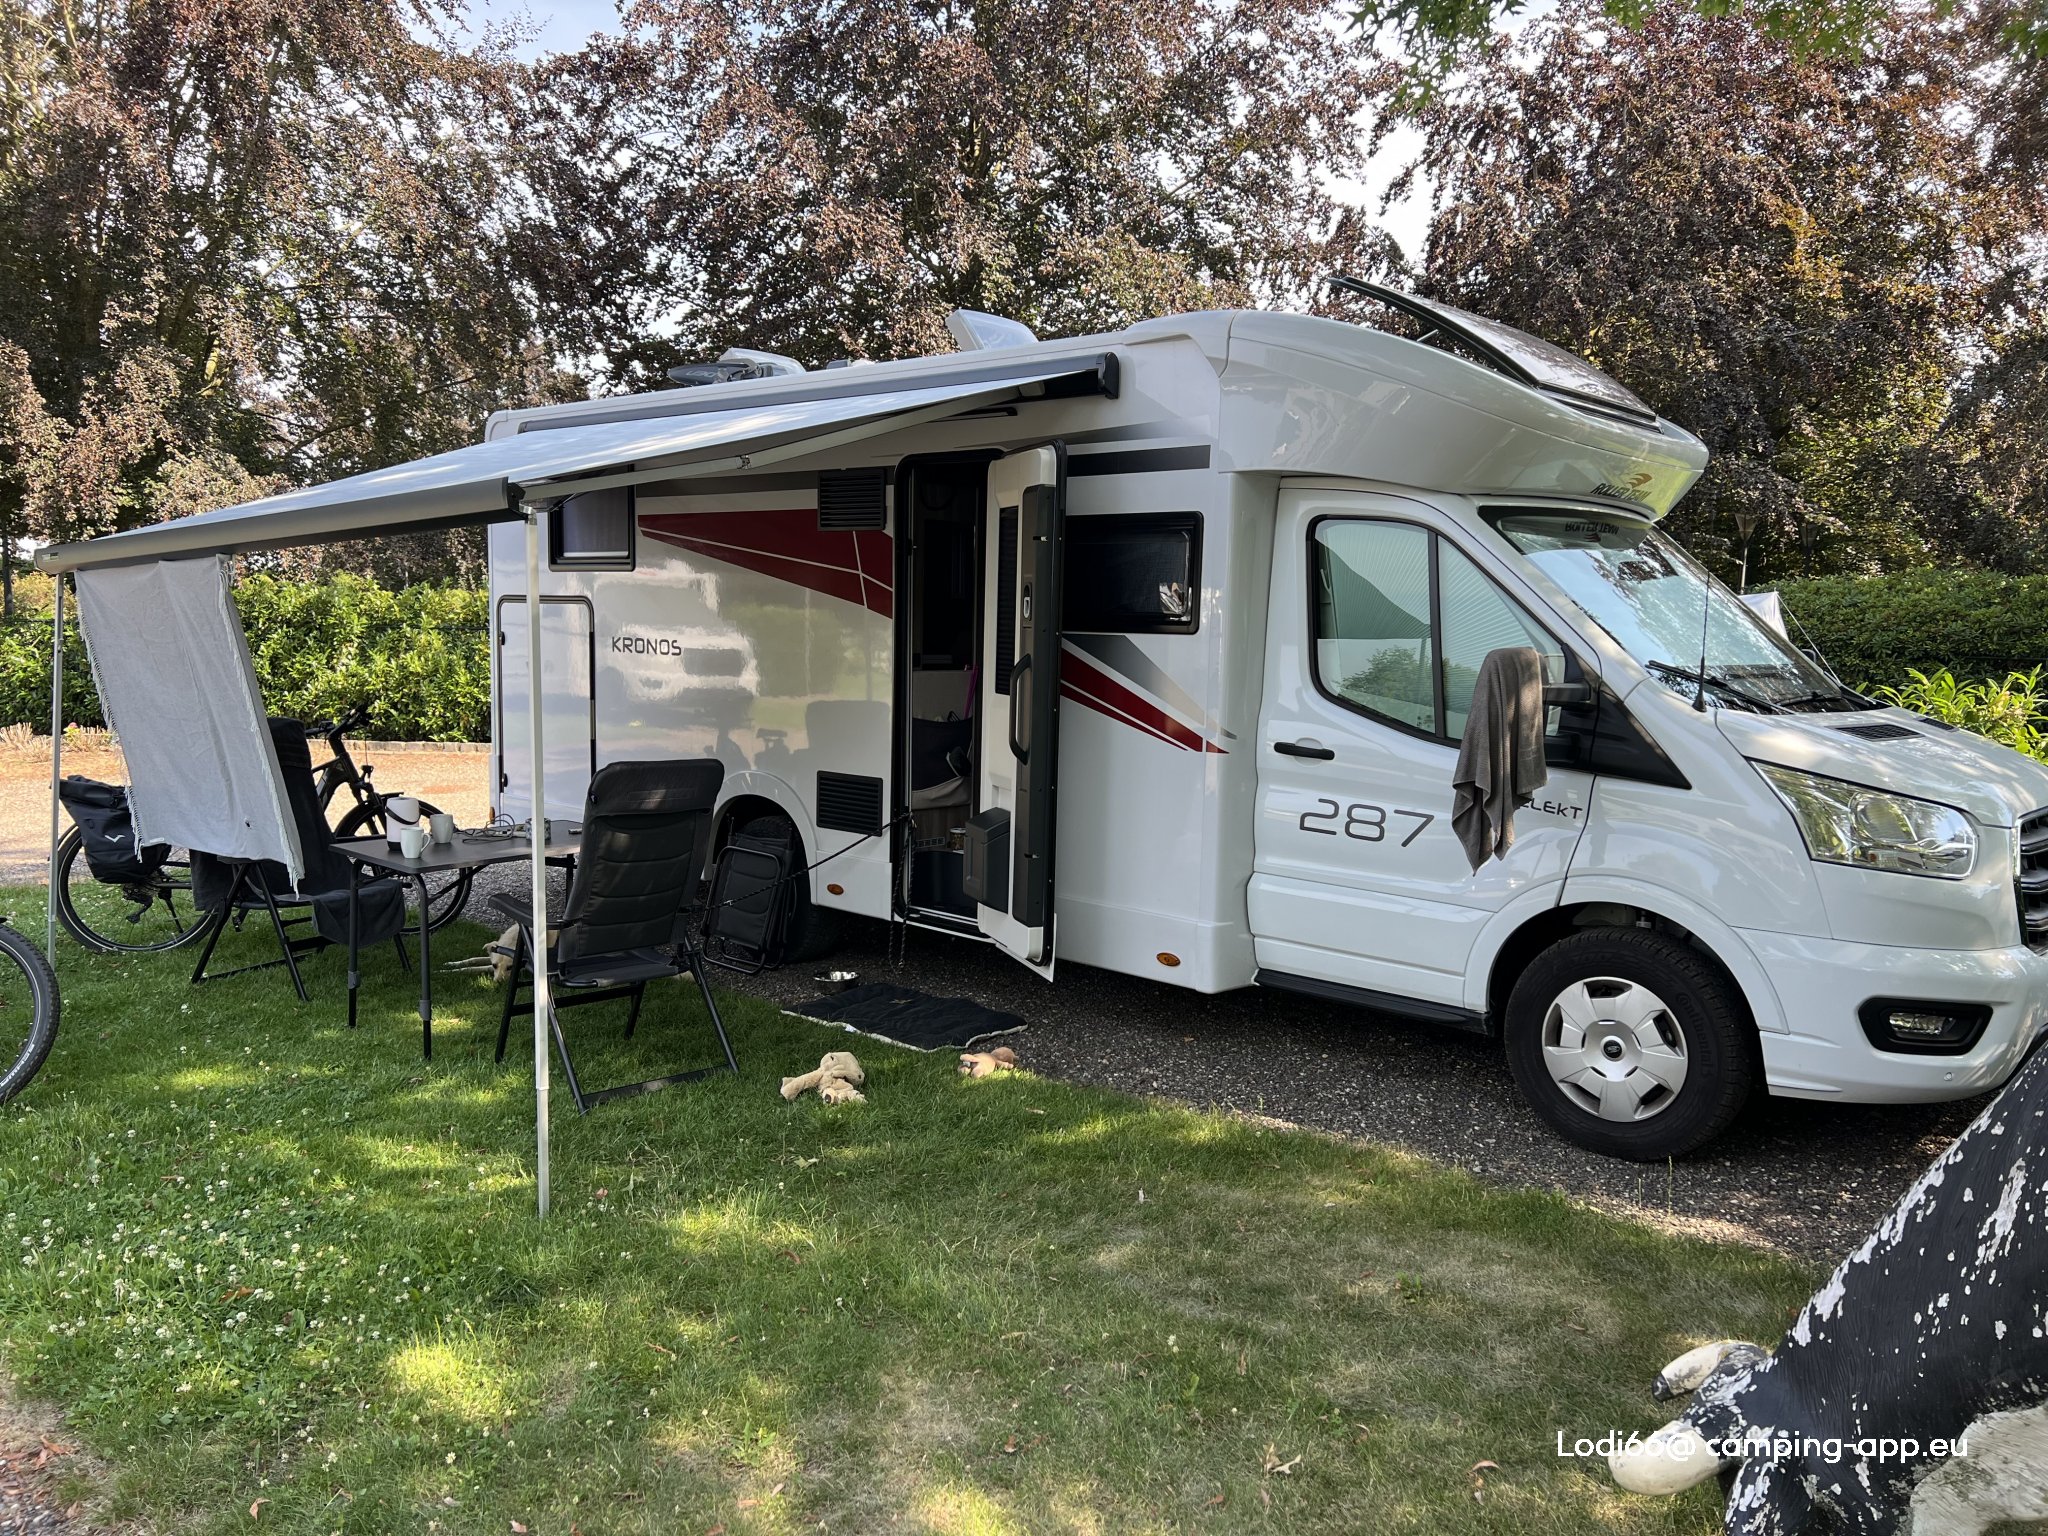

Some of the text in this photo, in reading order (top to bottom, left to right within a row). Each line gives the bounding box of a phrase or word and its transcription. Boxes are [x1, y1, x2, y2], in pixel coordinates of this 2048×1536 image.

[1590, 482, 1652, 501] ROLLER TEAM
[612, 636, 682, 656] KRONOS
[1299, 798, 1435, 848] 287
